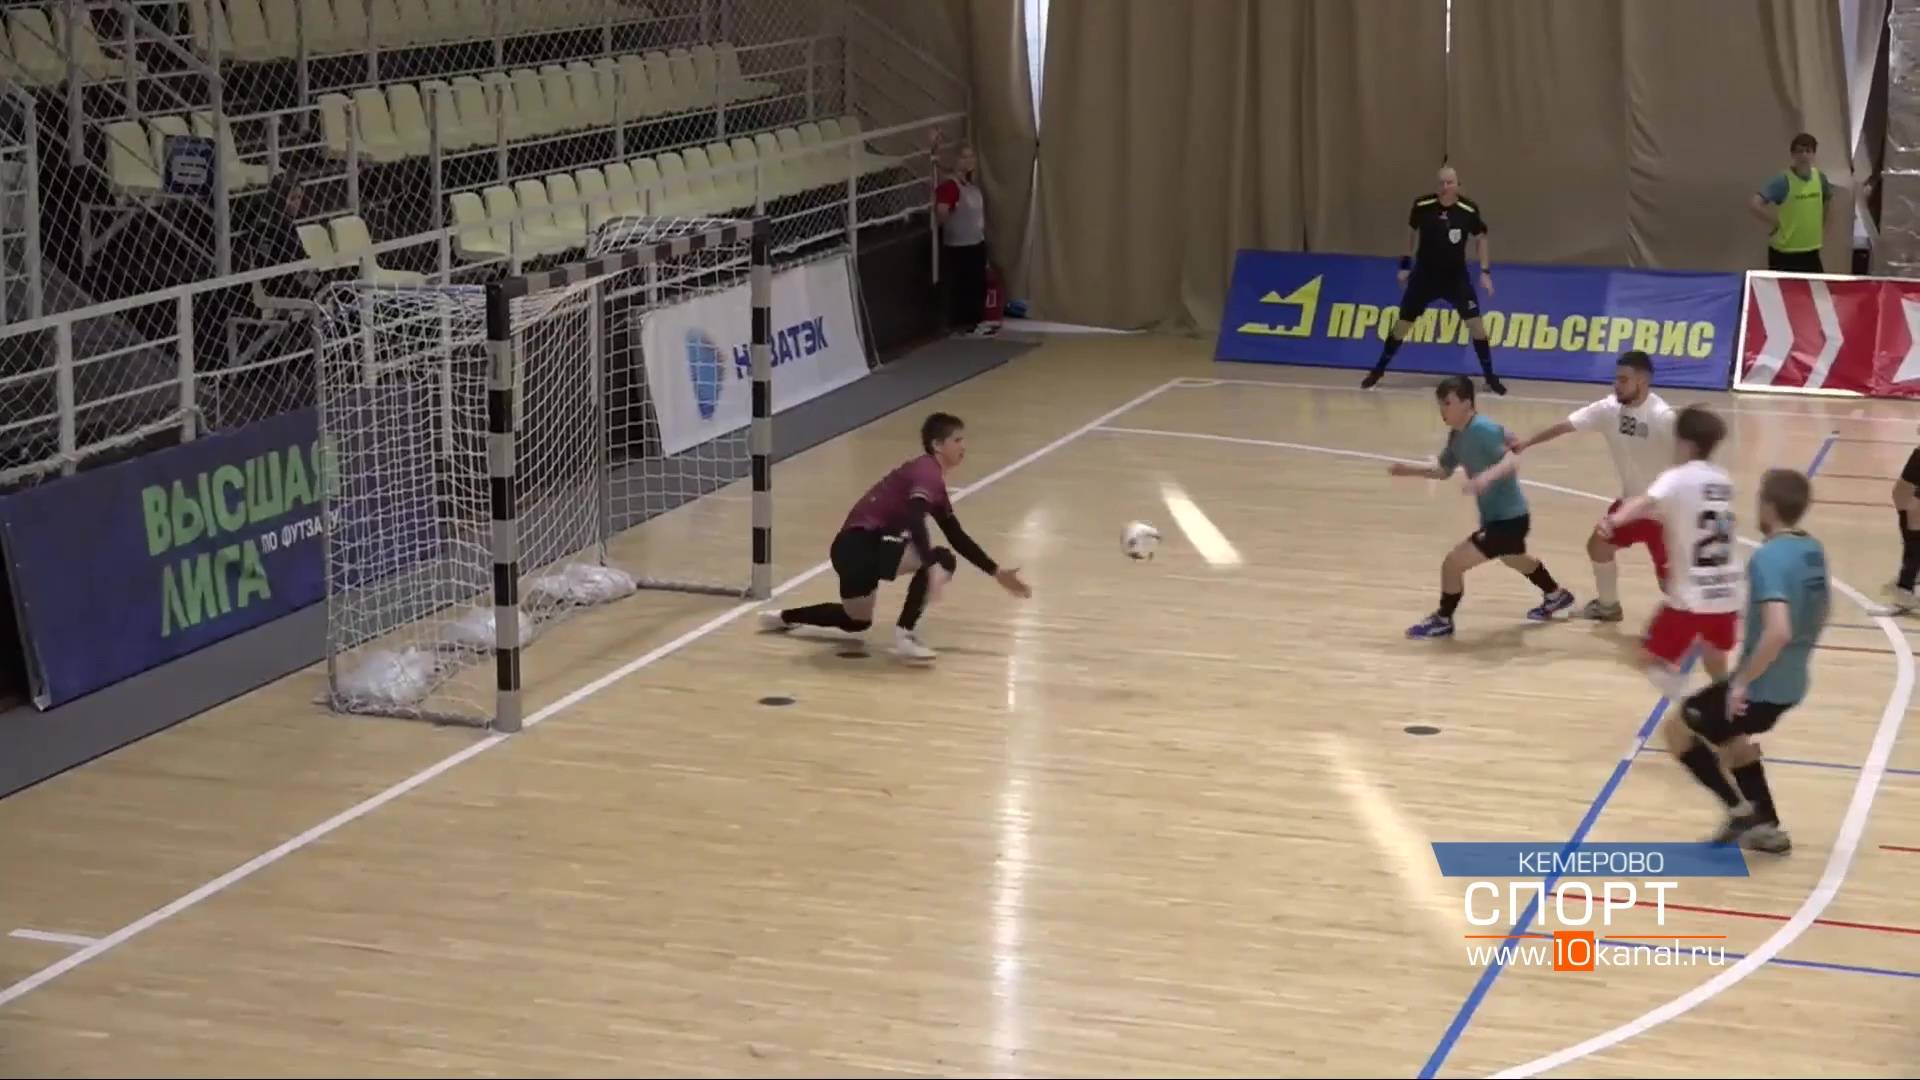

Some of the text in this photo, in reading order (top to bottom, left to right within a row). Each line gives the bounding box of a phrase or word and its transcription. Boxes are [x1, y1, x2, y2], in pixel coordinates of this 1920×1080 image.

[733, 315, 829, 380] НВАТЭК
[141, 434, 340, 556] ВЫСШАЯ
[261, 509, 339, 553] ПО ФУТЗАУ
[161, 539, 271, 638] ЛИГА
